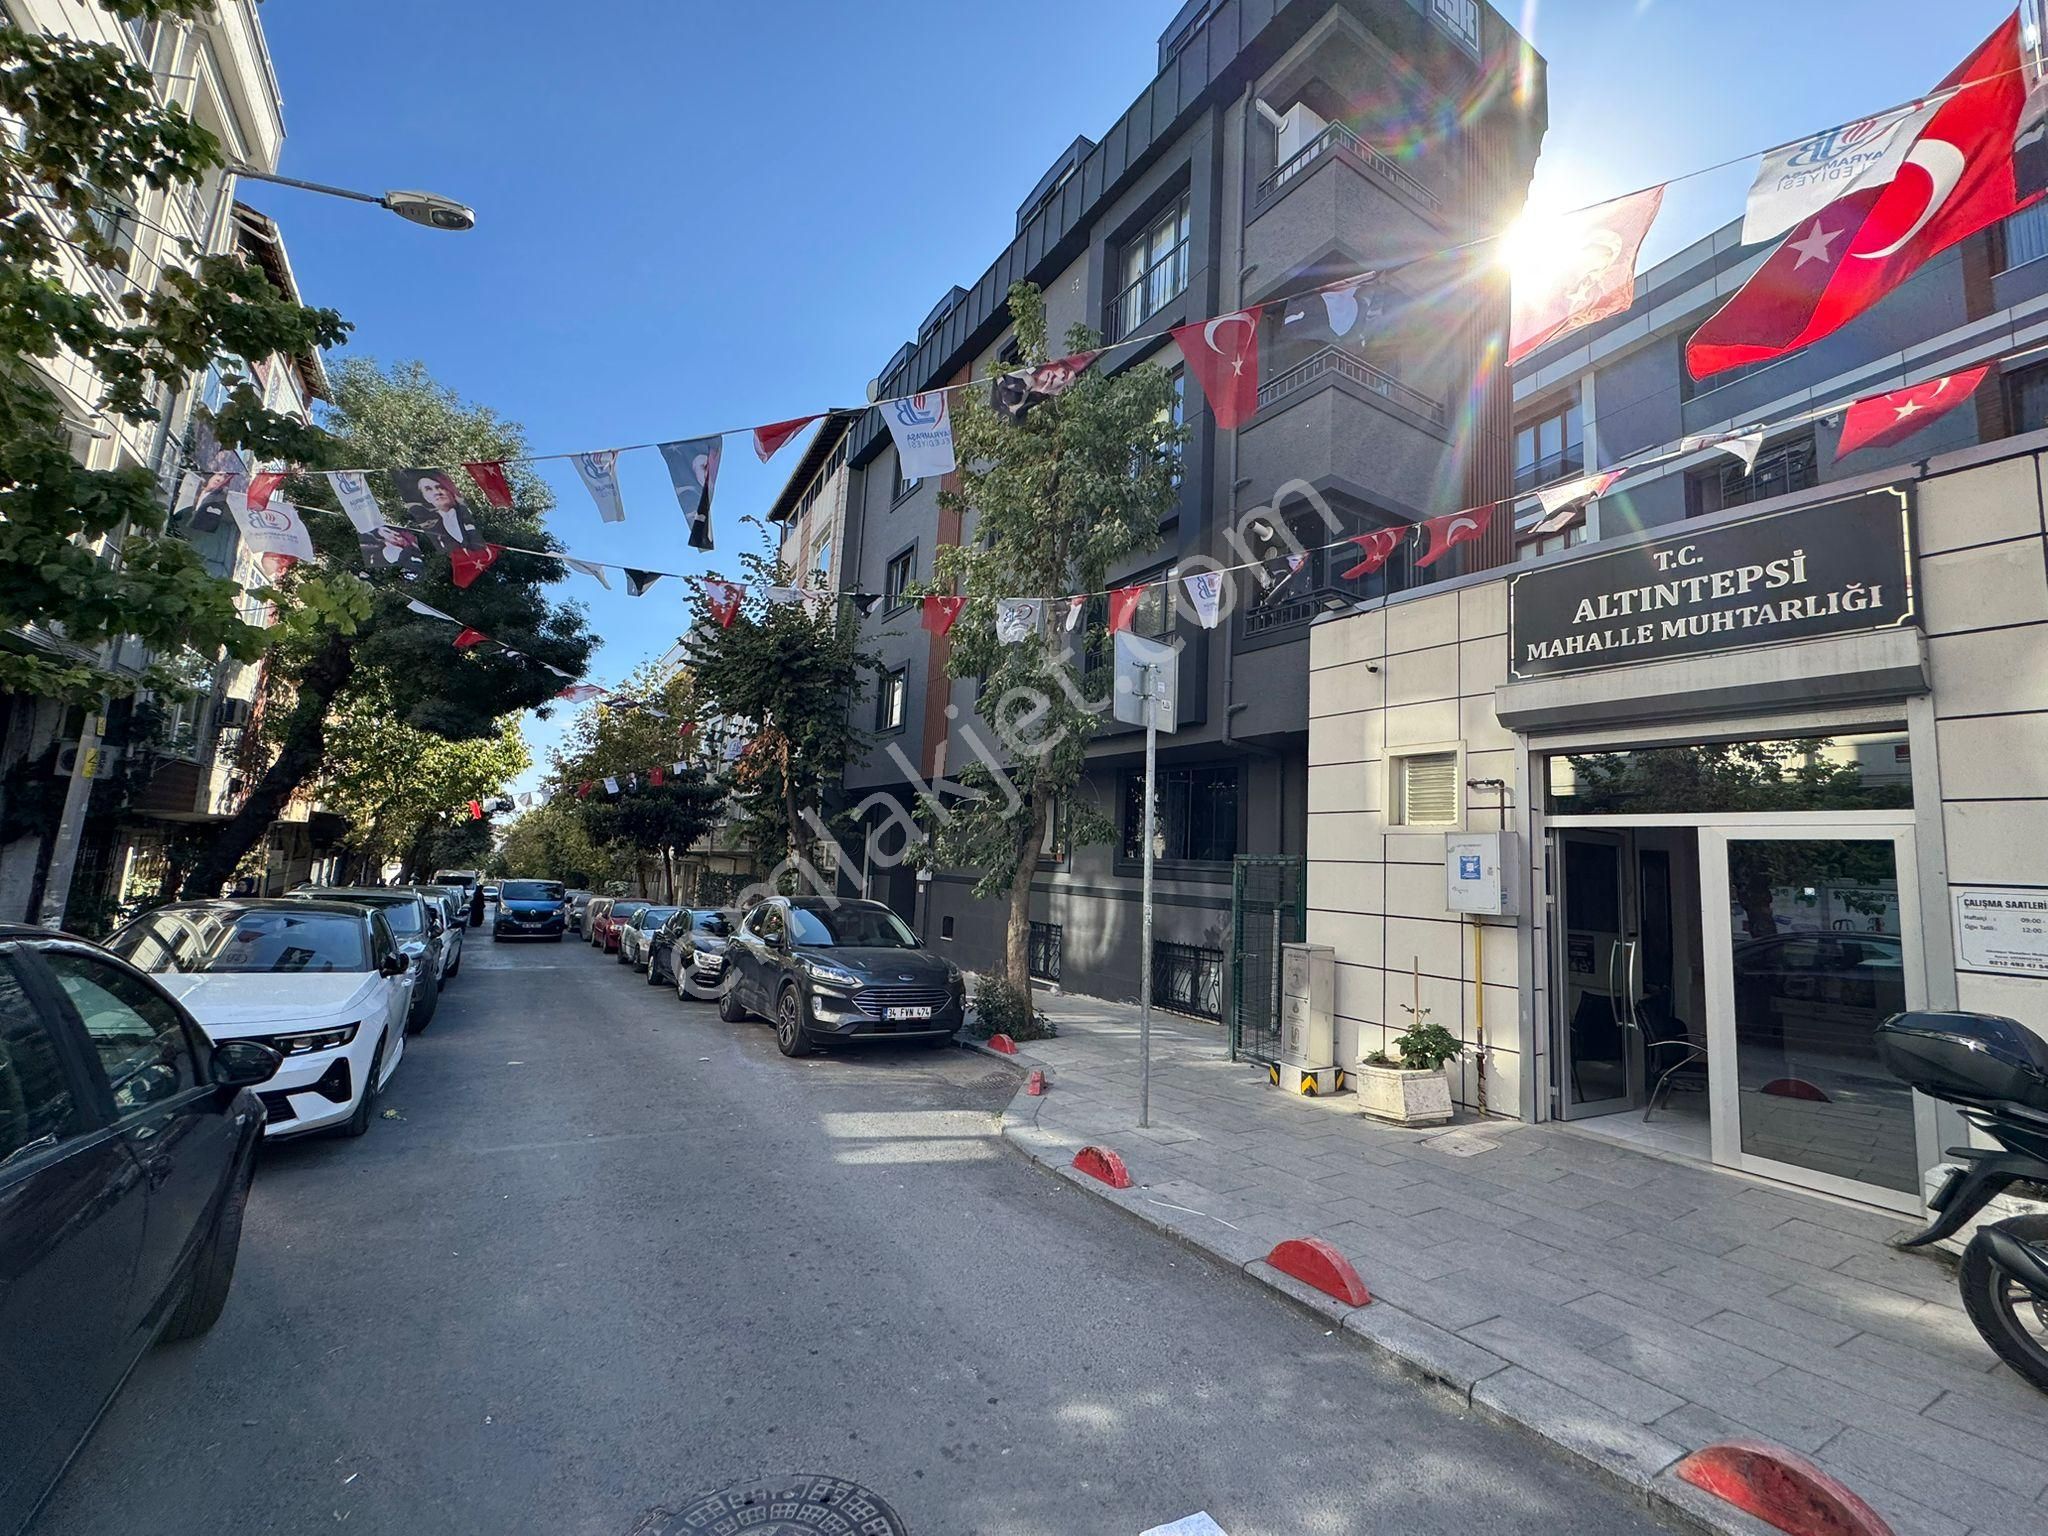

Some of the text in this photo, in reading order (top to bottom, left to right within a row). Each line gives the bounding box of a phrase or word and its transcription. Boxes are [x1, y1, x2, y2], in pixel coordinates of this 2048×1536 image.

[1653, 545, 1703, 572] T.C.
[1572, 549, 1808, 624] ALTINTEPSİ
[1527, 582, 1884, 662] MAHALLE MUHTARLIĞI
[1964, 899, 2047, 910] ÇALIŞMA SAATLERİ
[888, 1008, 897, 1017] 34
